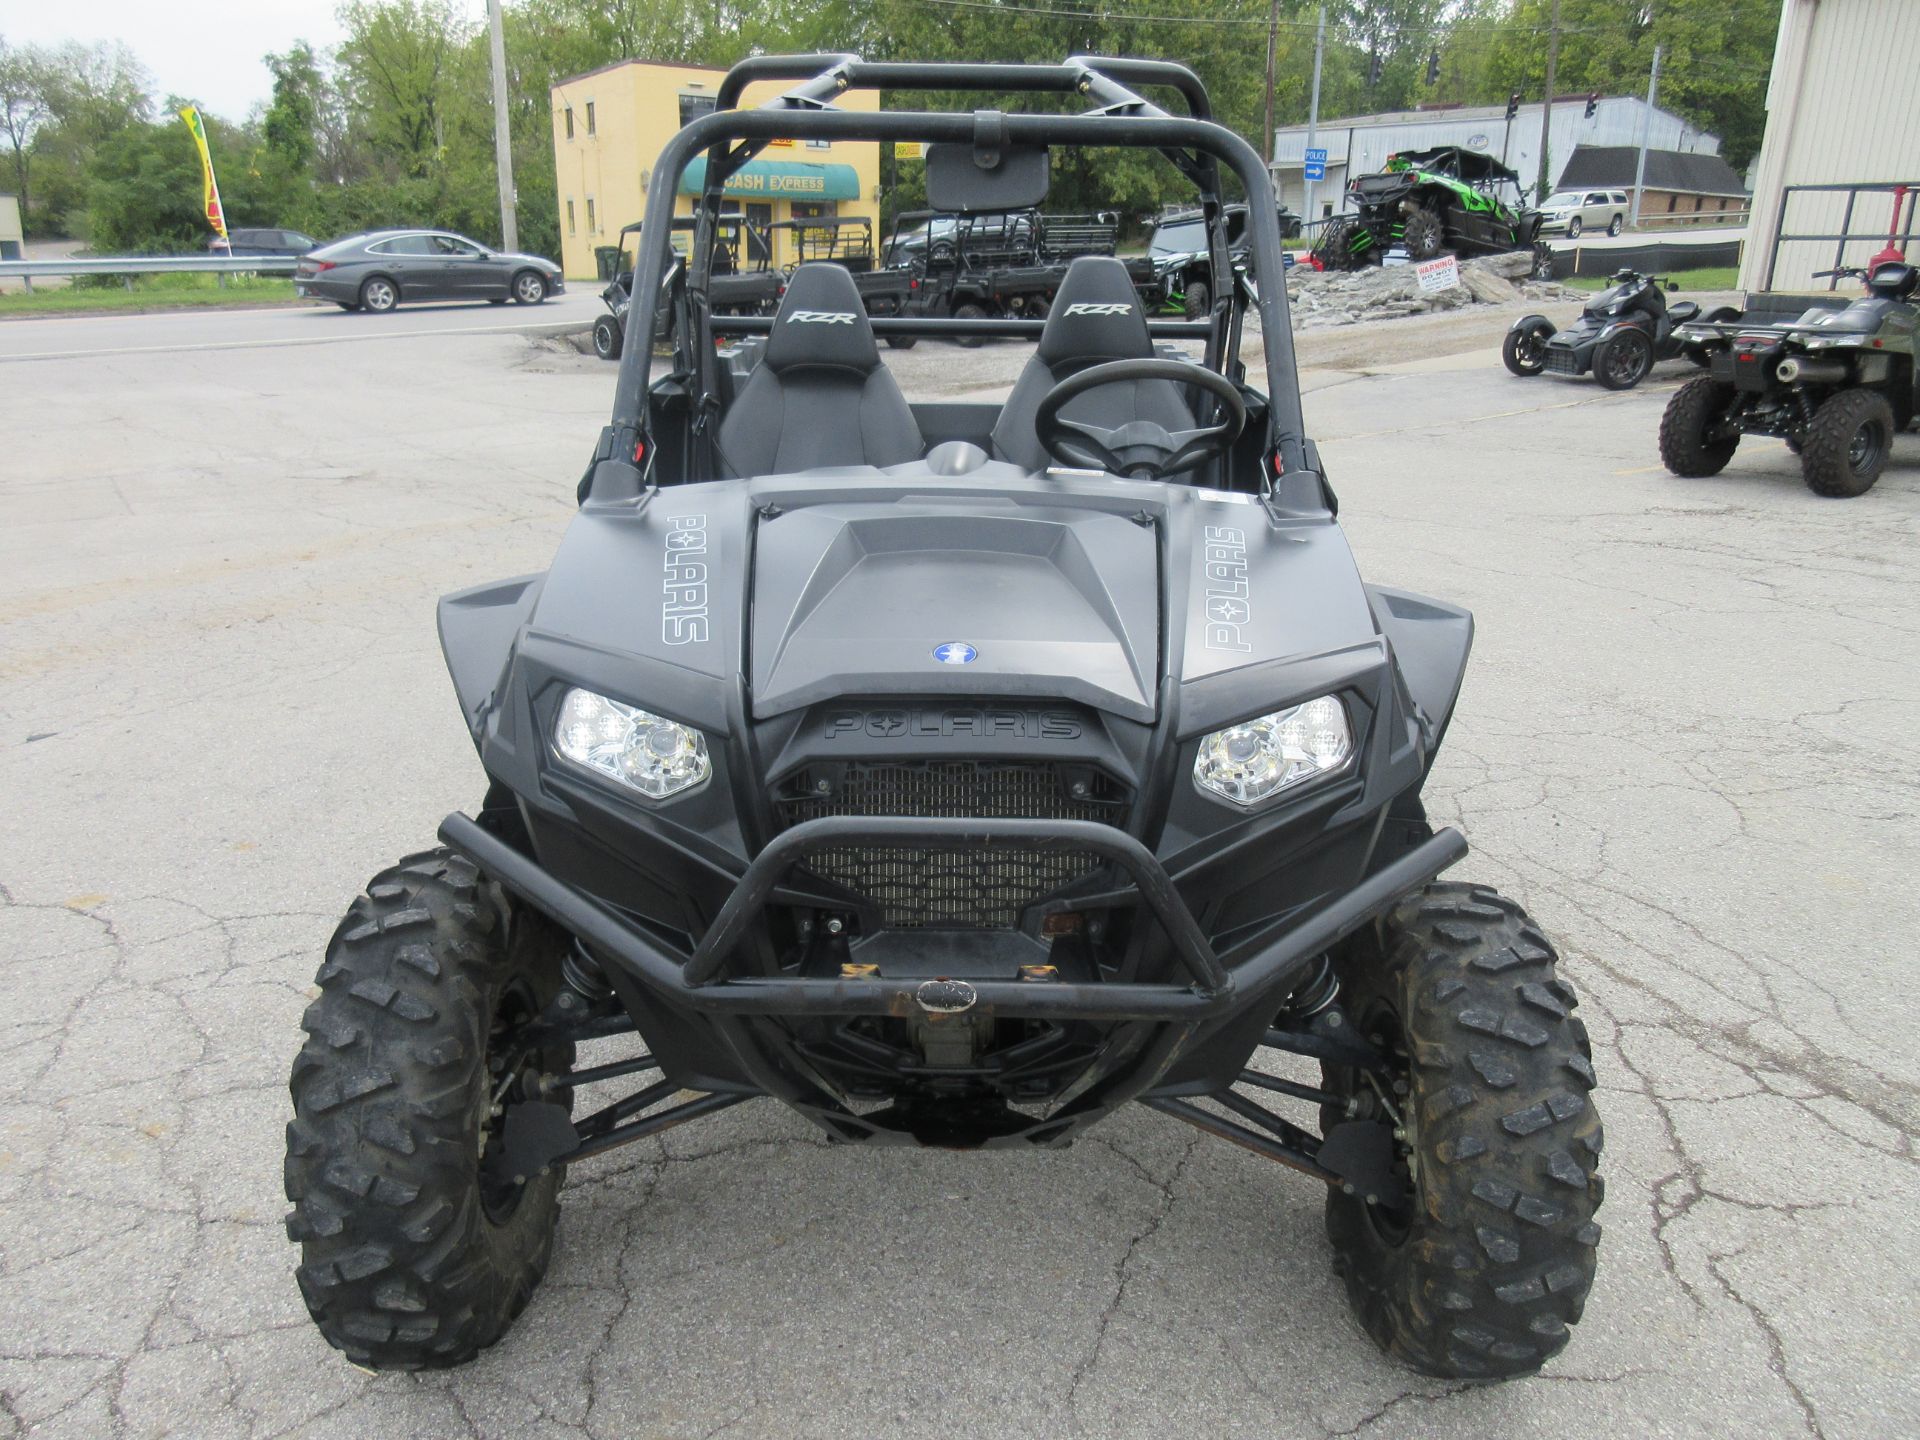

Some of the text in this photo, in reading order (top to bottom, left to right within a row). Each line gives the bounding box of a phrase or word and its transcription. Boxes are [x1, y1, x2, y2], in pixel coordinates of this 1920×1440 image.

[1306, 151, 1326, 161] POLICE
[724, 174, 825, 192] CASH EXPRESS
[1419, 259, 1454, 274] WARNING
[786, 310, 858, 325] RZR
[1063, 303, 1133, 317] RZR
[662, 514, 709, 646] POLARIS
[1204, 525, 1252, 653] POLARIS
[824, 709, 1082, 740] POLARIS
